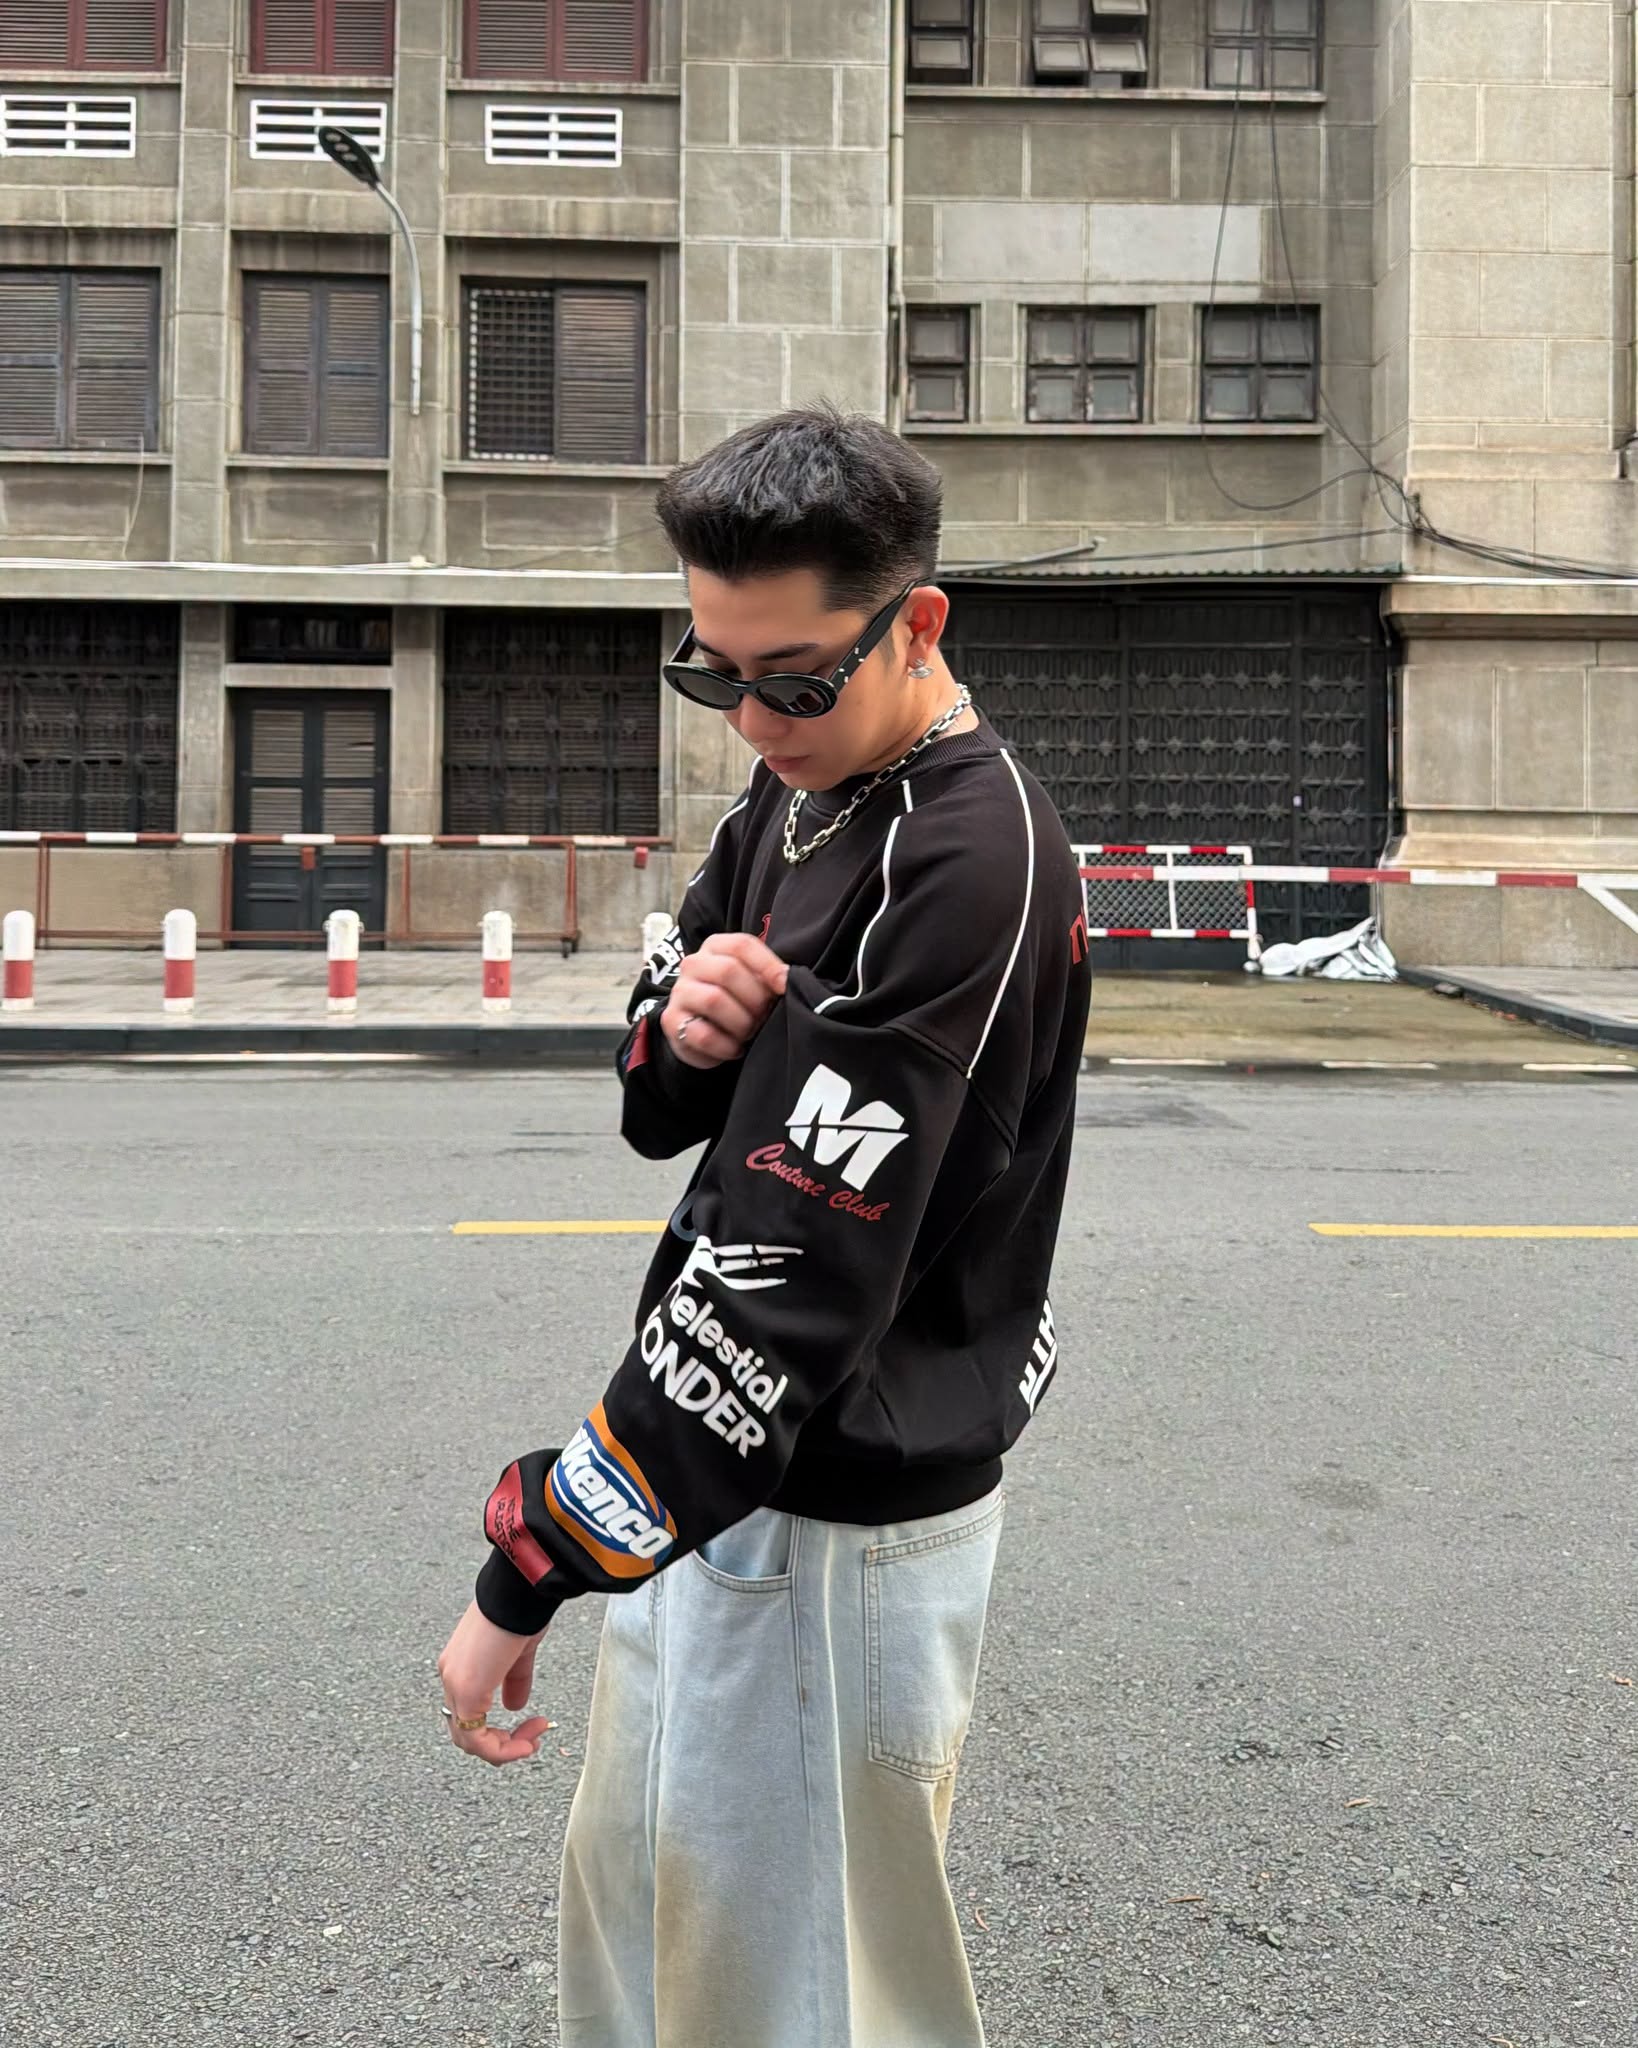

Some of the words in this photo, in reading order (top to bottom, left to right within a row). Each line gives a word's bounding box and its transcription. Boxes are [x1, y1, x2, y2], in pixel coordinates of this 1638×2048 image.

[746, 1143, 826, 1197] Couture
[829, 1190, 890, 1221] Club
[641, 1304, 766, 1459] ONDER
